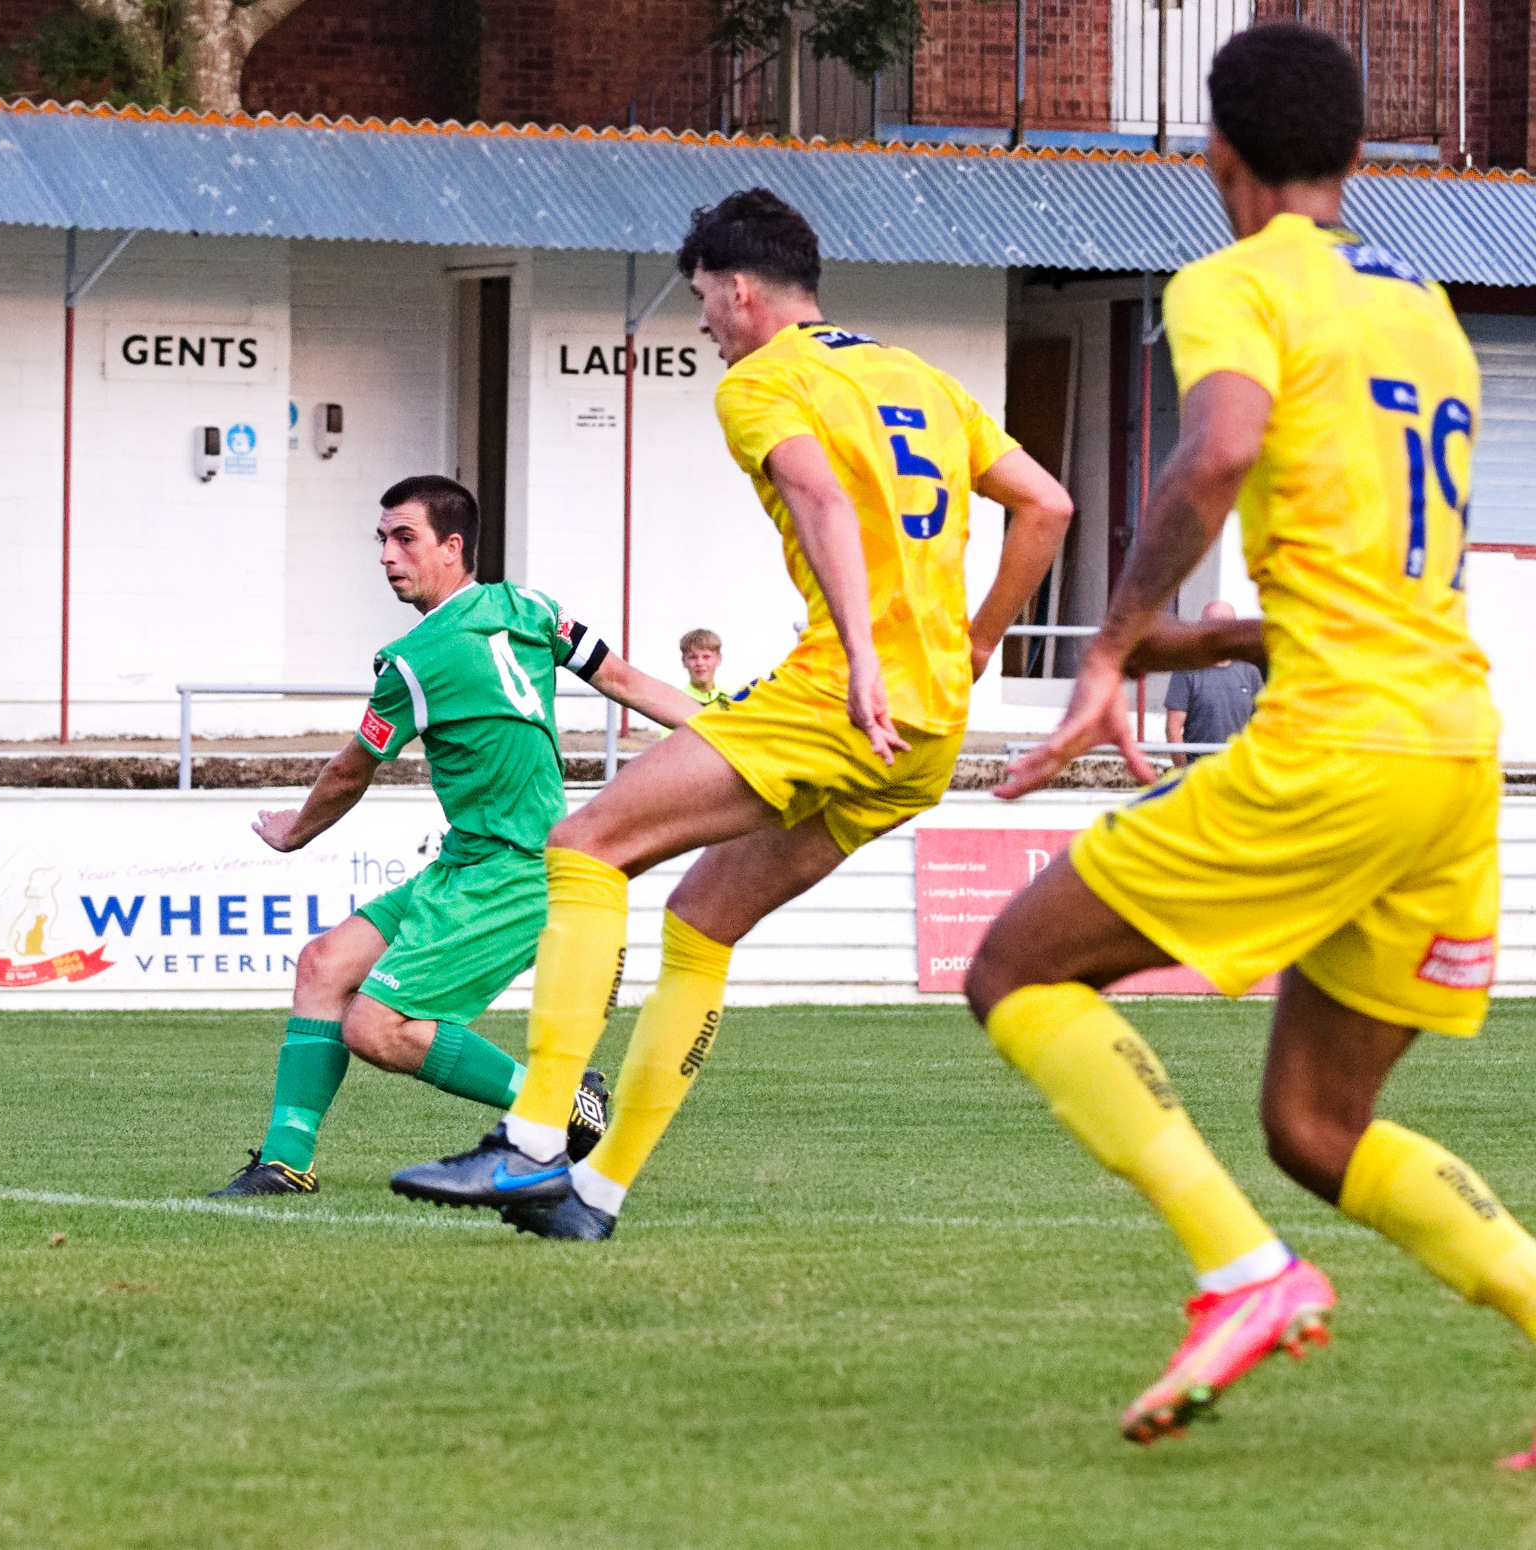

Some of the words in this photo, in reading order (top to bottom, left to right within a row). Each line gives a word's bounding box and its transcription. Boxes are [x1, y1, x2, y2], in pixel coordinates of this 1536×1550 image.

[122, 334, 257, 369] GENTS
[560, 344, 697, 377] LADIES
[877, 405, 949, 539] 5
[487, 629, 546, 721] 4
[126, 861, 206, 880] Complete
[350, 851, 406, 885] the
[79, 894, 355, 937] WHEEL
[680, 1009, 719, 1079] oneills
